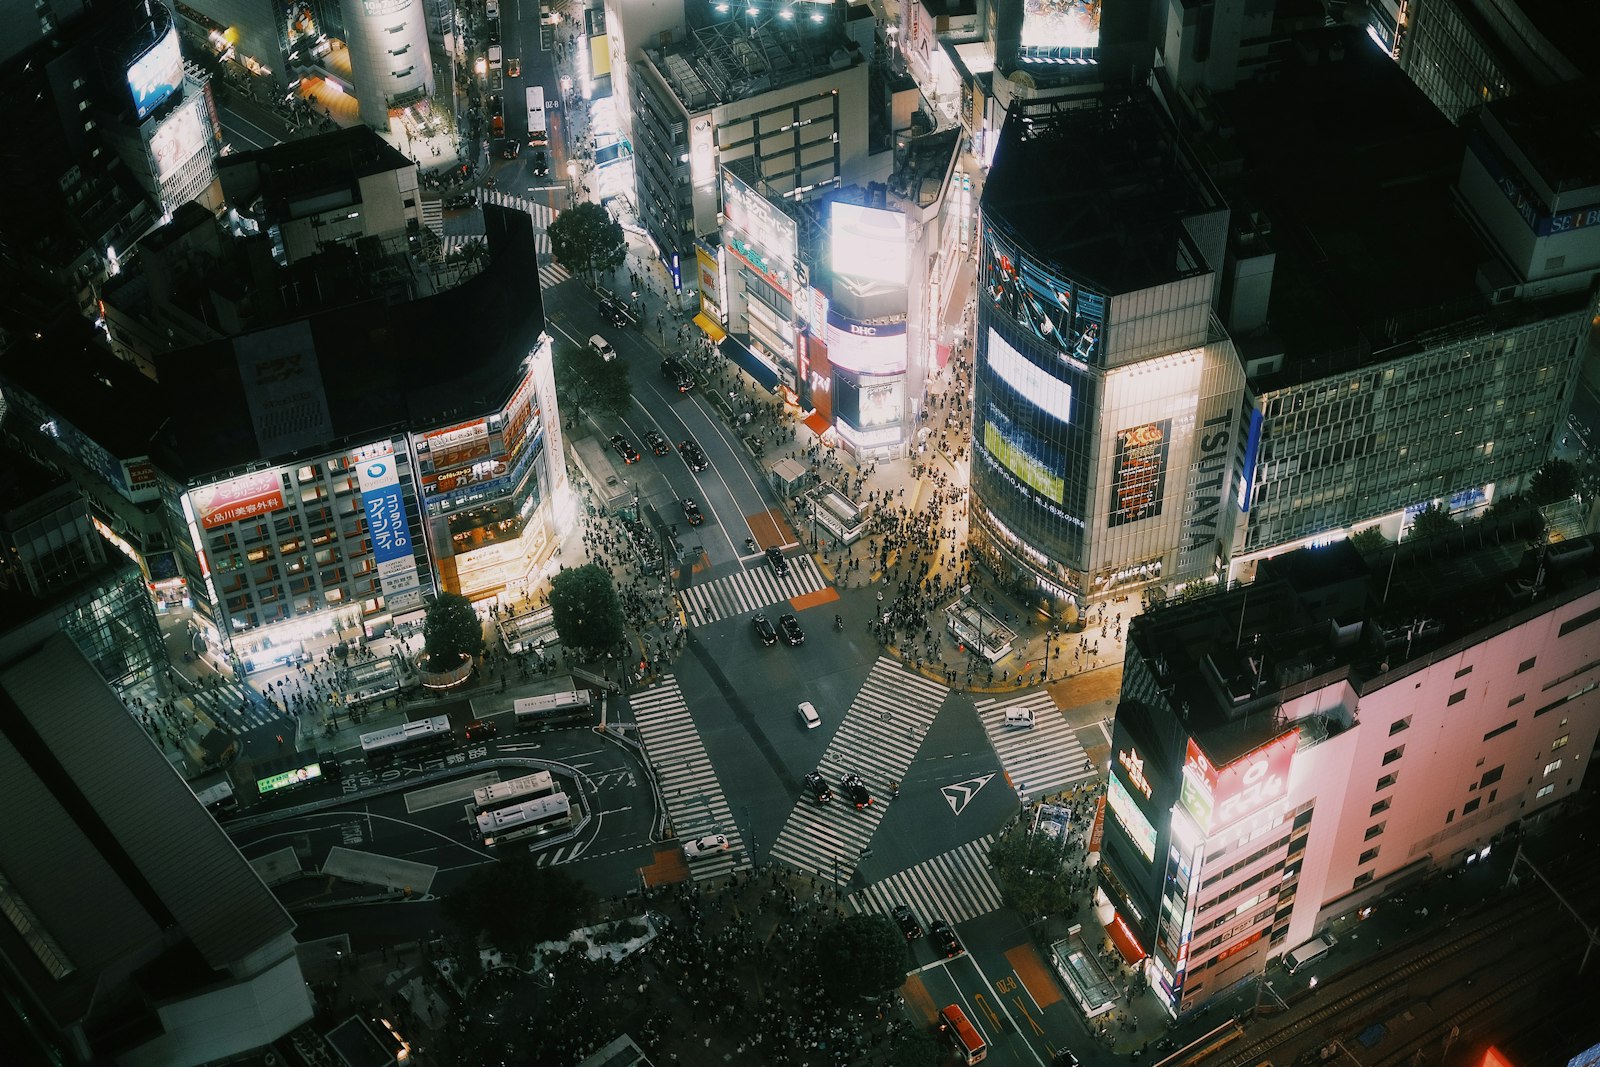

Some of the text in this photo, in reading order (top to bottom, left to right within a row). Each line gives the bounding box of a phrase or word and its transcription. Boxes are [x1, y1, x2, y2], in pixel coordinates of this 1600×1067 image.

[850, 324, 877, 336] DHC
[416, 441, 428, 450] 9F
[423, 483, 437, 493] 7F
[1188, 407, 1233, 552] TSUTAYA
[213, 497, 279, 523] 品川美容外科
[386, 493, 407, 547] コンタクトの
[367, 497, 392, 550] アイシティ
[996, 976, 1017, 994] 8-20
